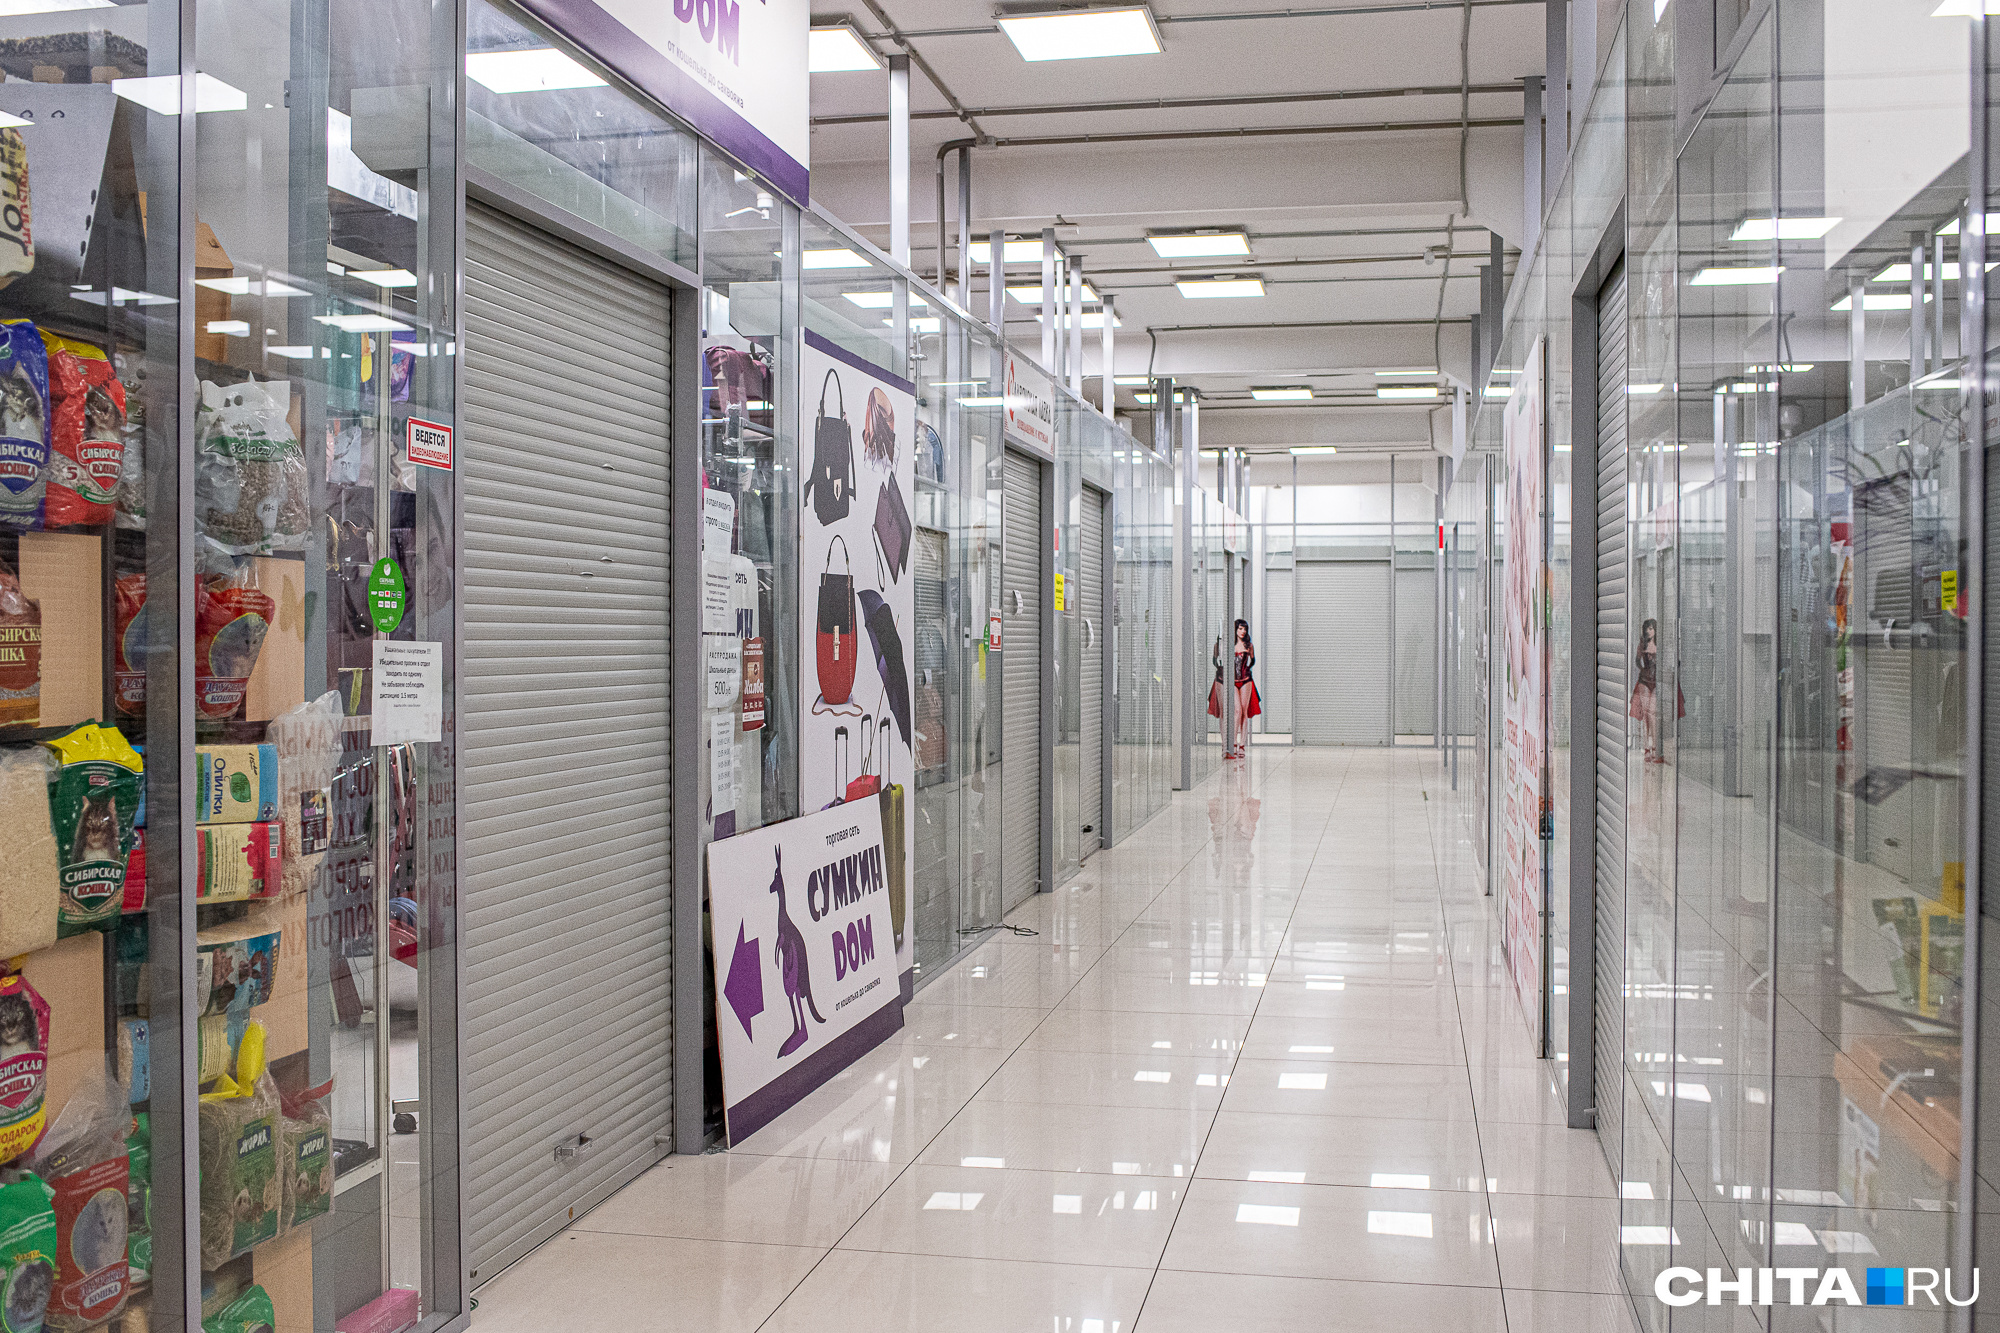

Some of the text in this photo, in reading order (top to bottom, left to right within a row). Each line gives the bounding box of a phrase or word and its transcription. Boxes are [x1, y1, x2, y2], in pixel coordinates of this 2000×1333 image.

[667, 40, 744, 109] от кошелька до саквояжа
[415, 428, 446, 448] ВЕДЕТСЯ
[0, 443, 45, 463] БИРСКАЯ
[80, 447, 123, 461] СИБИРСК
[65, 466, 78, 481] 5
[709, 651, 738, 660] РАСПРОДАЖА
[714, 681, 726, 695] 500
[744, 679, 764, 695] Халва
[825, 825, 861, 847] торговая сеть
[64, 867, 122, 883] СИБИРСКАЯ
[807, 843, 884, 923] СУМКИН
[76, 881, 113, 898] КОШКА
[832, 913, 875, 982] DOM
[835, 977, 881, 1011] от кошелька до саквояжа
